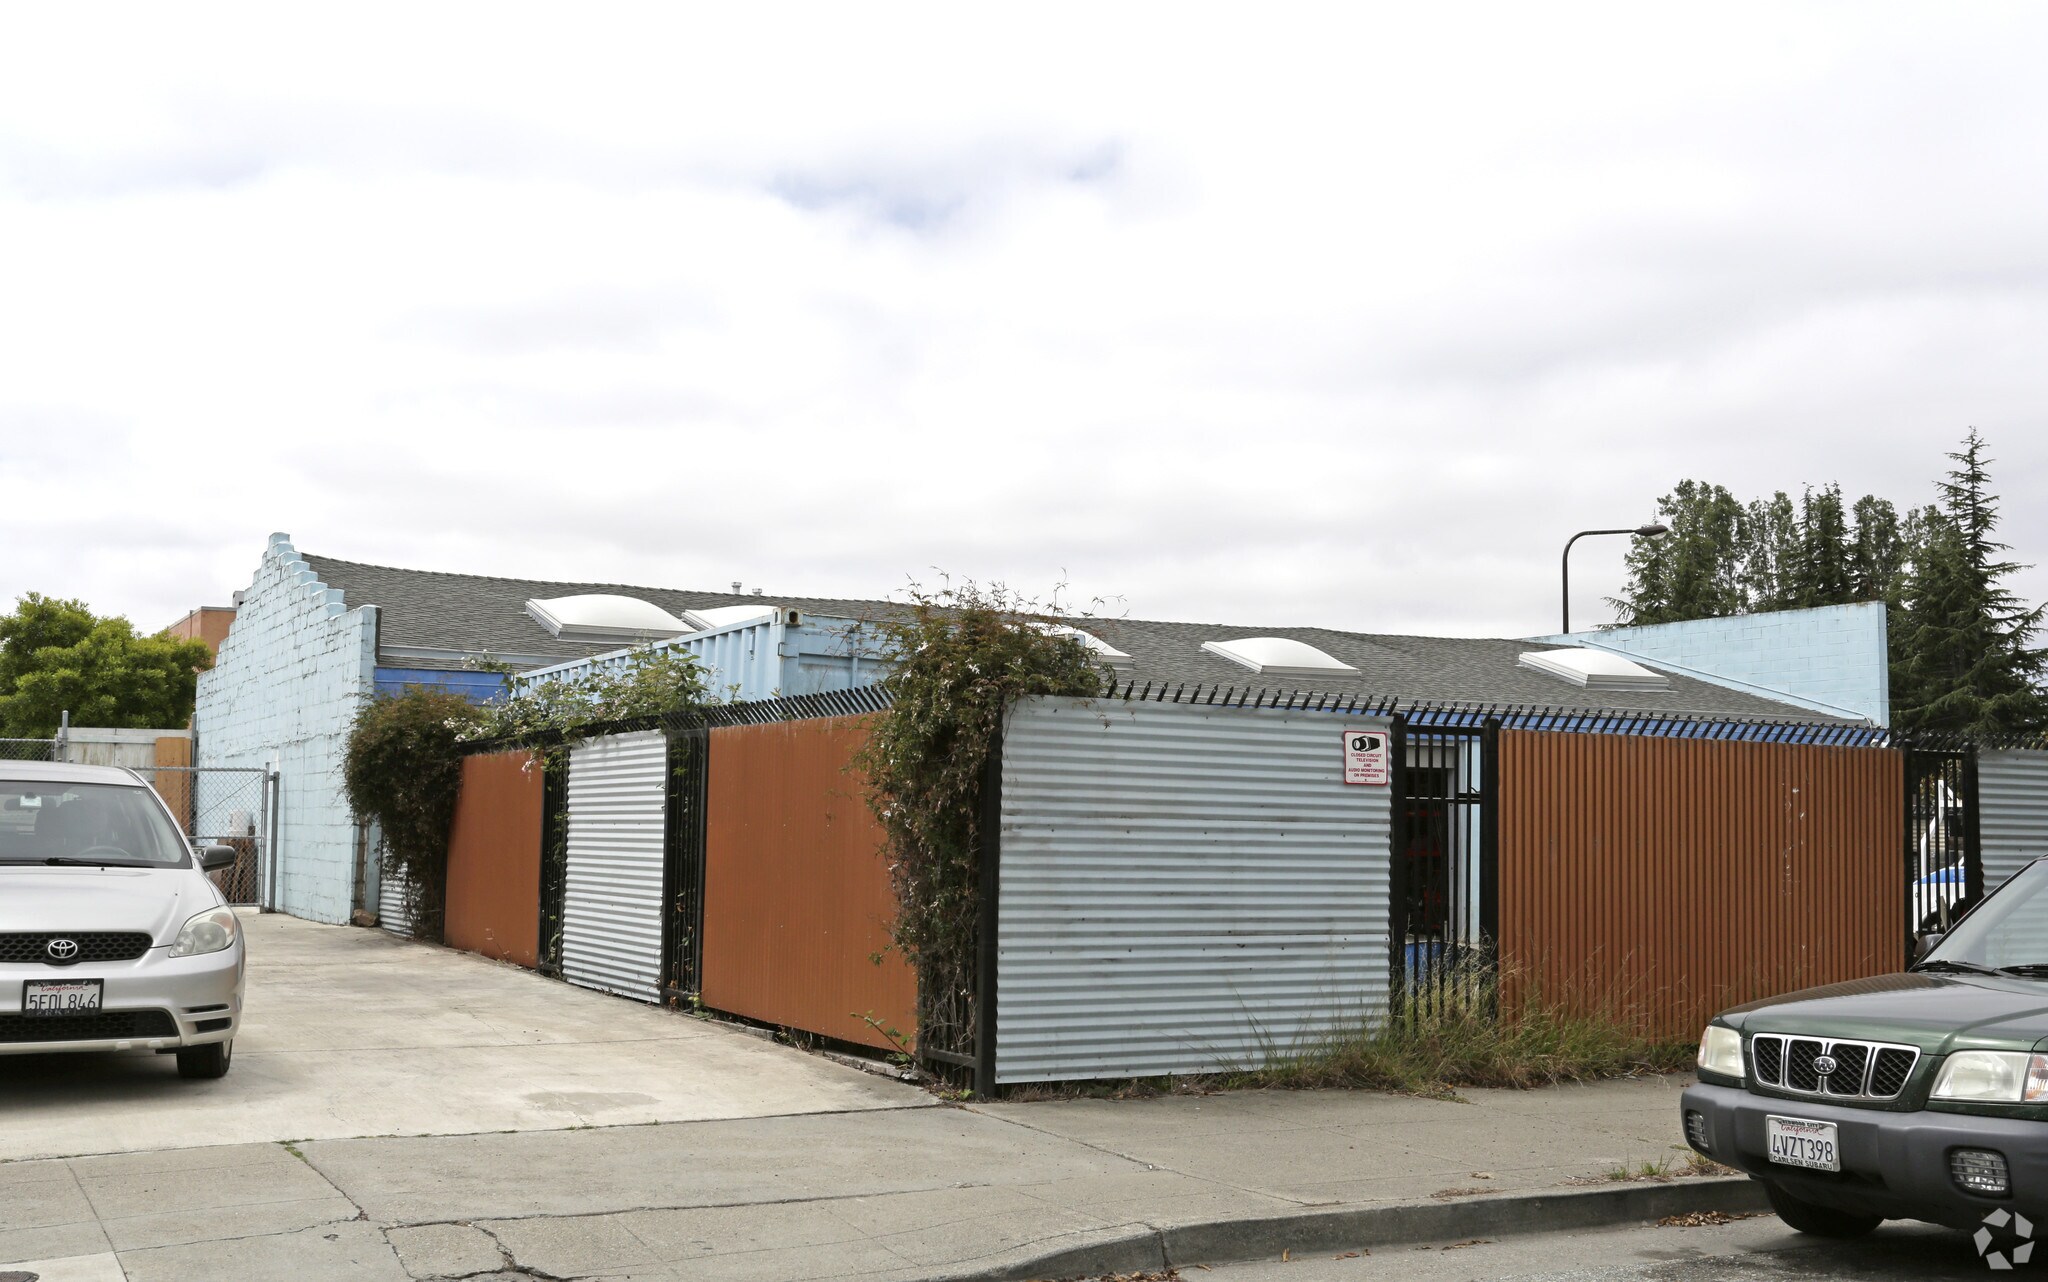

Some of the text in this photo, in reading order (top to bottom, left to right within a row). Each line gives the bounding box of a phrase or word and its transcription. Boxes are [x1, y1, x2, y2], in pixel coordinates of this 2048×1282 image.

[1772, 1133, 1833, 1162] 4VZT398
[1773, 1156, 1833, 1170] CARLSEN SUBARU
